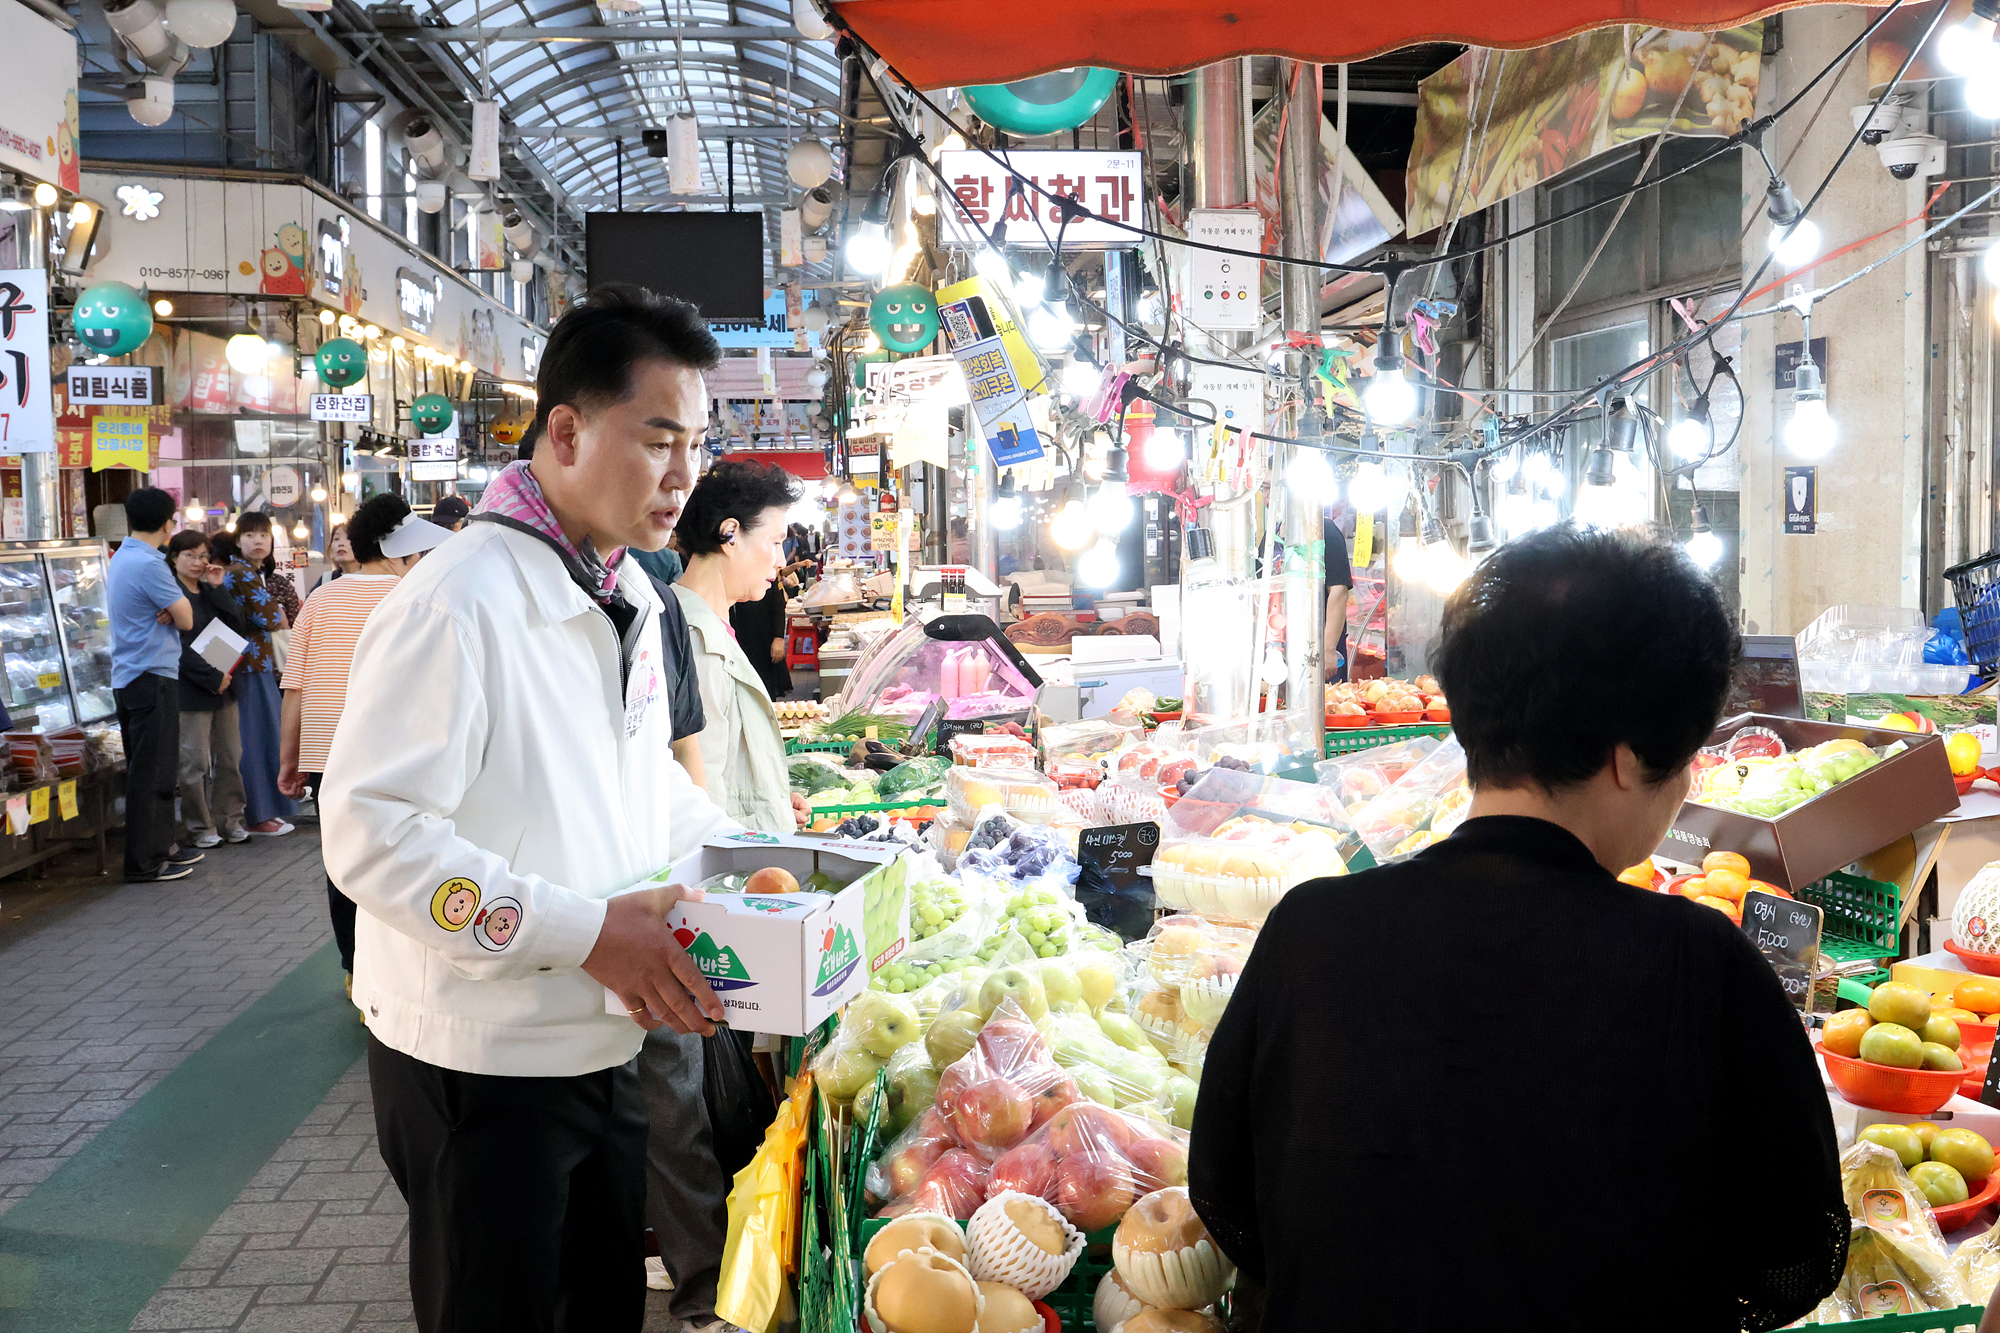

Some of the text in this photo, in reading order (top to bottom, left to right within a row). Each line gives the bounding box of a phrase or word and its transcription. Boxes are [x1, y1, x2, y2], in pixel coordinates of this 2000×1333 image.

[1107, 159, 1135, 169] 2문-11
[954, 173, 1135, 224] 황씨청과
[1200, 227, 1220, 235] 자동문
[140, 266, 230, 280] 010-8577-0967
[960, 349, 1006, 380] 민생회복
[72, 376, 148, 399] 태림식품
[969, 372, 1016, 402] 소비쿠폰
[1202, 383, 1223, 391] 자동문
[316, 396, 365, 411] 성화전집
[97, 422, 143, 435] 우리동네
[97, 438, 144, 452] 단골시장
[410, 444, 455, 457] 종합축산
[1085, 833, 1101, 846] 샤인
[1672, 828, 1711, 849] 일품영농회
[1108, 850, 1134, 865] 5000
[1754, 900, 1777, 923] 연시
[1757, 926, 1789, 950] 5000
[687, 951, 731, 976] 바른
[723, 999, 762, 1012] 상자입니다.
